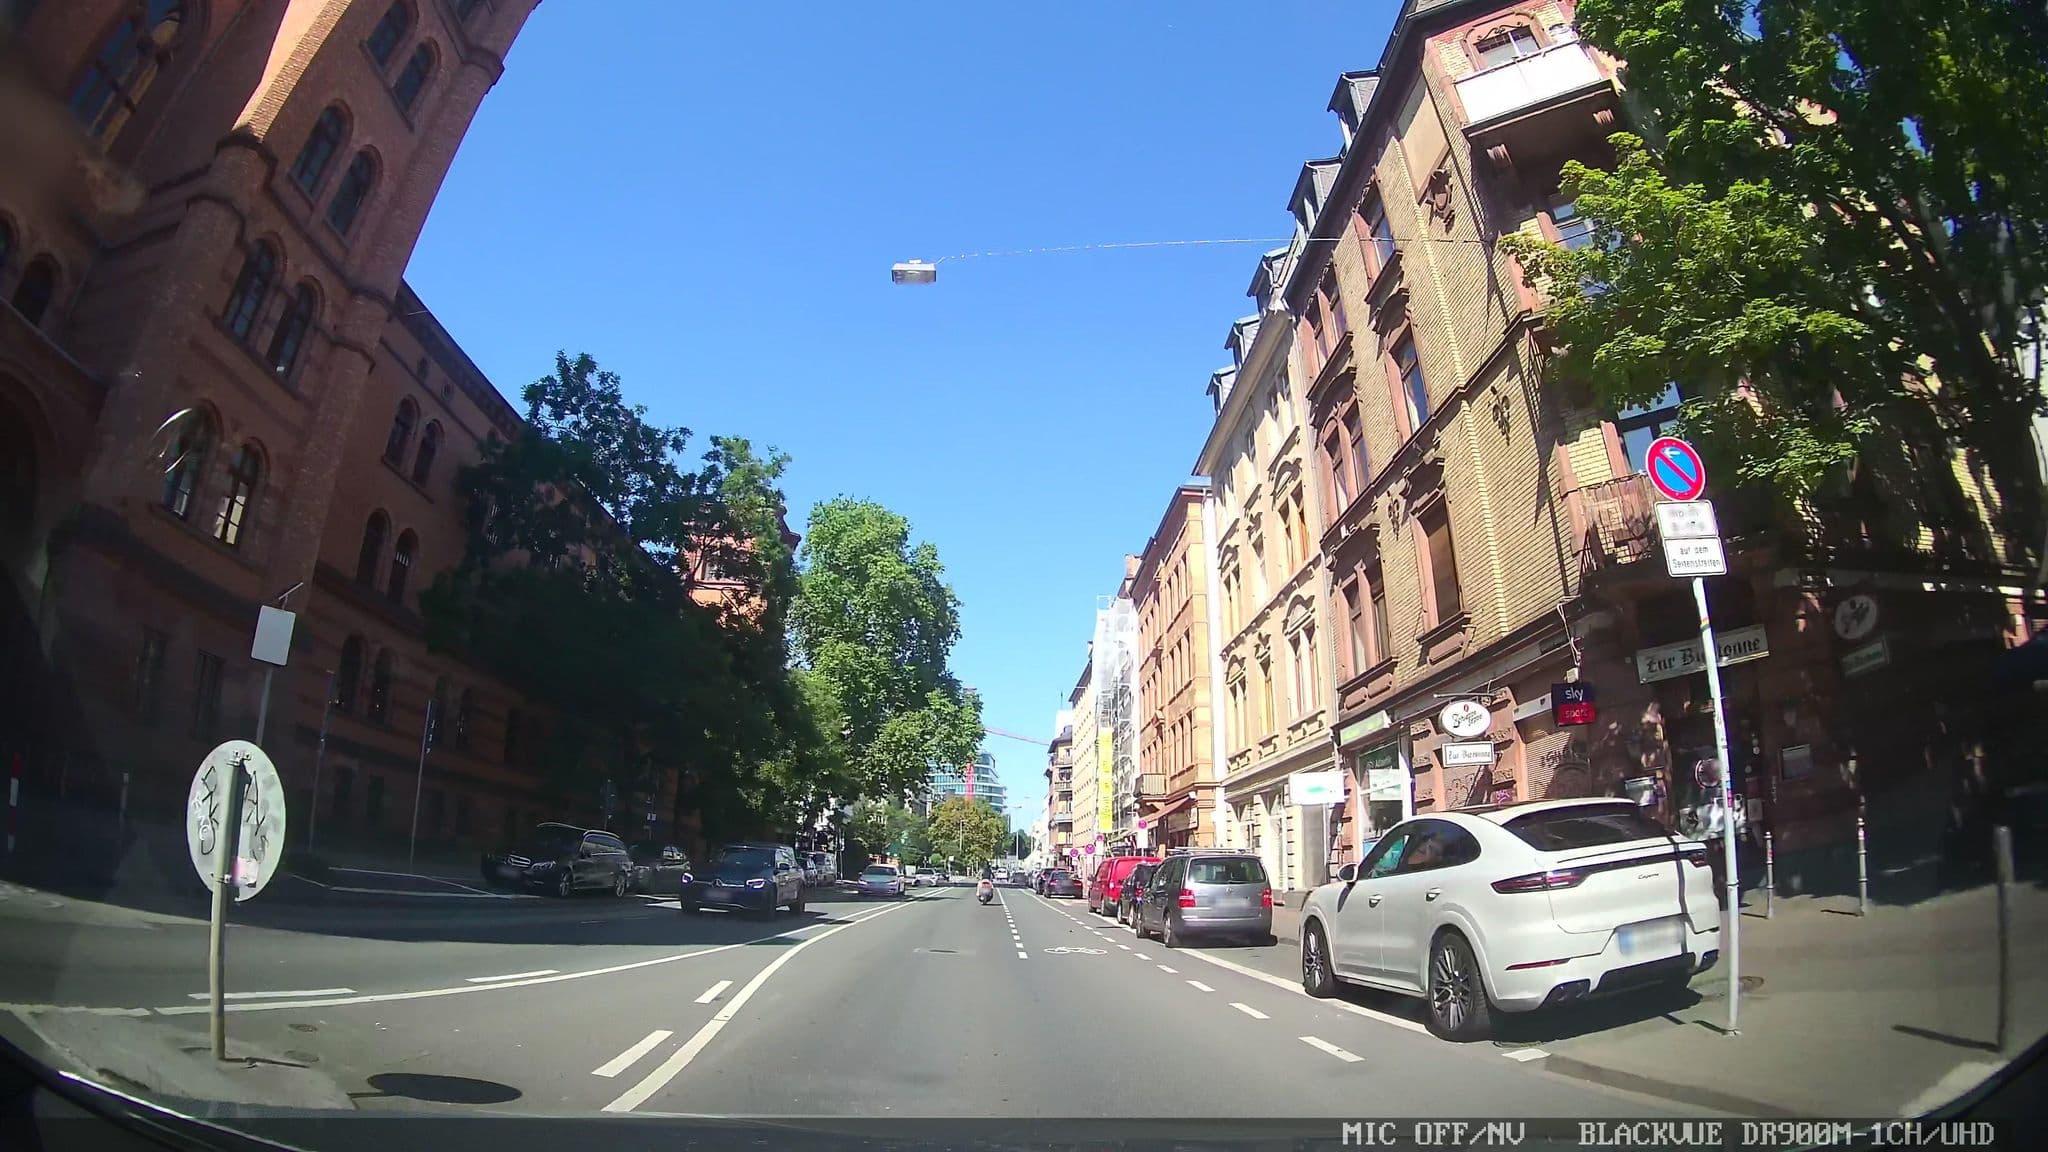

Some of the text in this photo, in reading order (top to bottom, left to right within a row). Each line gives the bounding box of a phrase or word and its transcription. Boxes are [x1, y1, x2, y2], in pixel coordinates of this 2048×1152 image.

[1679, 546, 1708, 555] auf dem
[1646, 656, 1676, 673] Zur
[1565, 687, 1583, 701] sky
